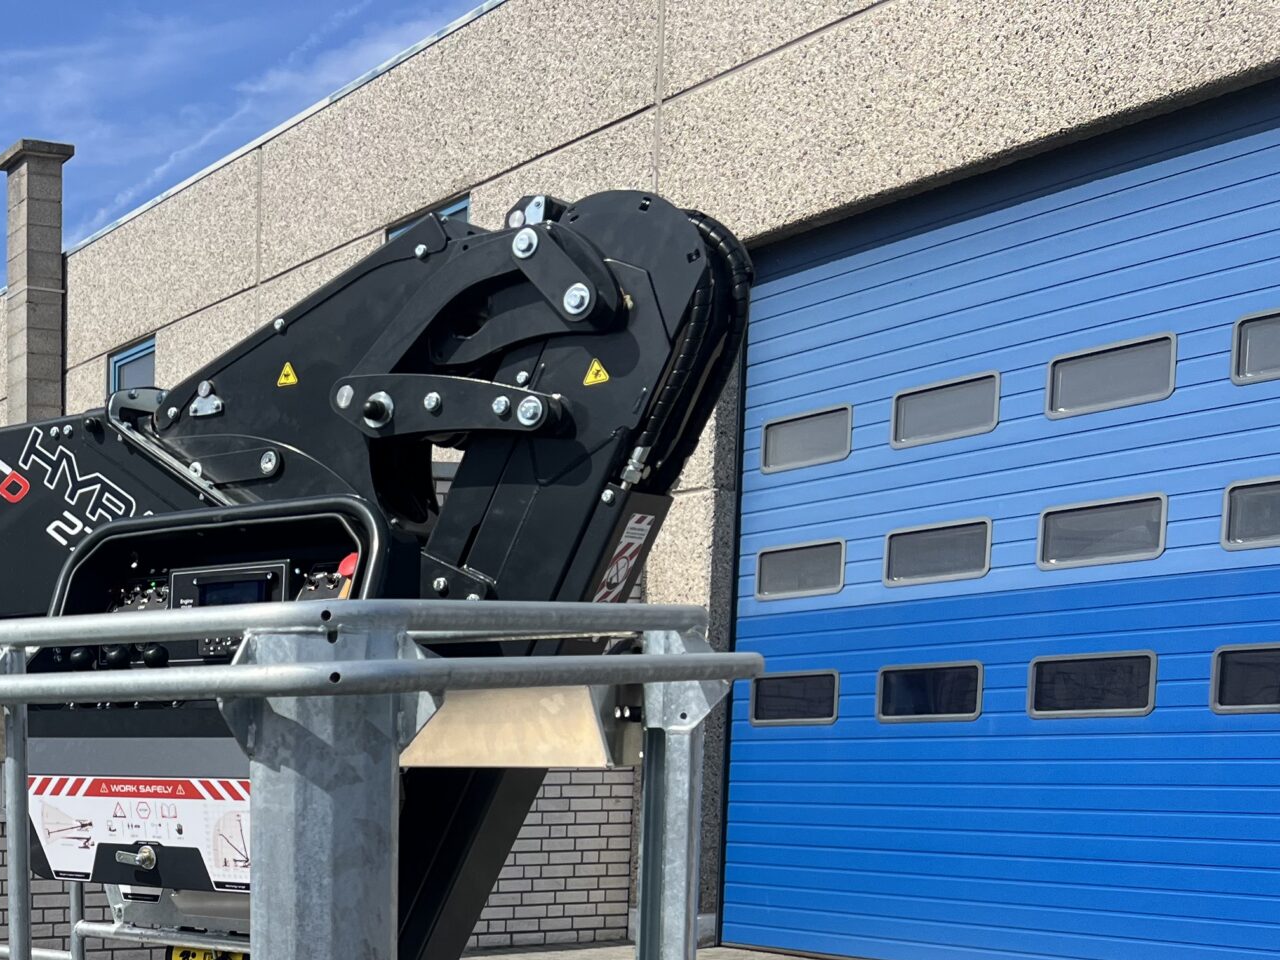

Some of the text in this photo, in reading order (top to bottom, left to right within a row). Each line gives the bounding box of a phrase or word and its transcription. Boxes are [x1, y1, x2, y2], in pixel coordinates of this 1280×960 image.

[18, 425, 138, 523] HYR
[110, 784, 173, 794] WORK SAFELY
